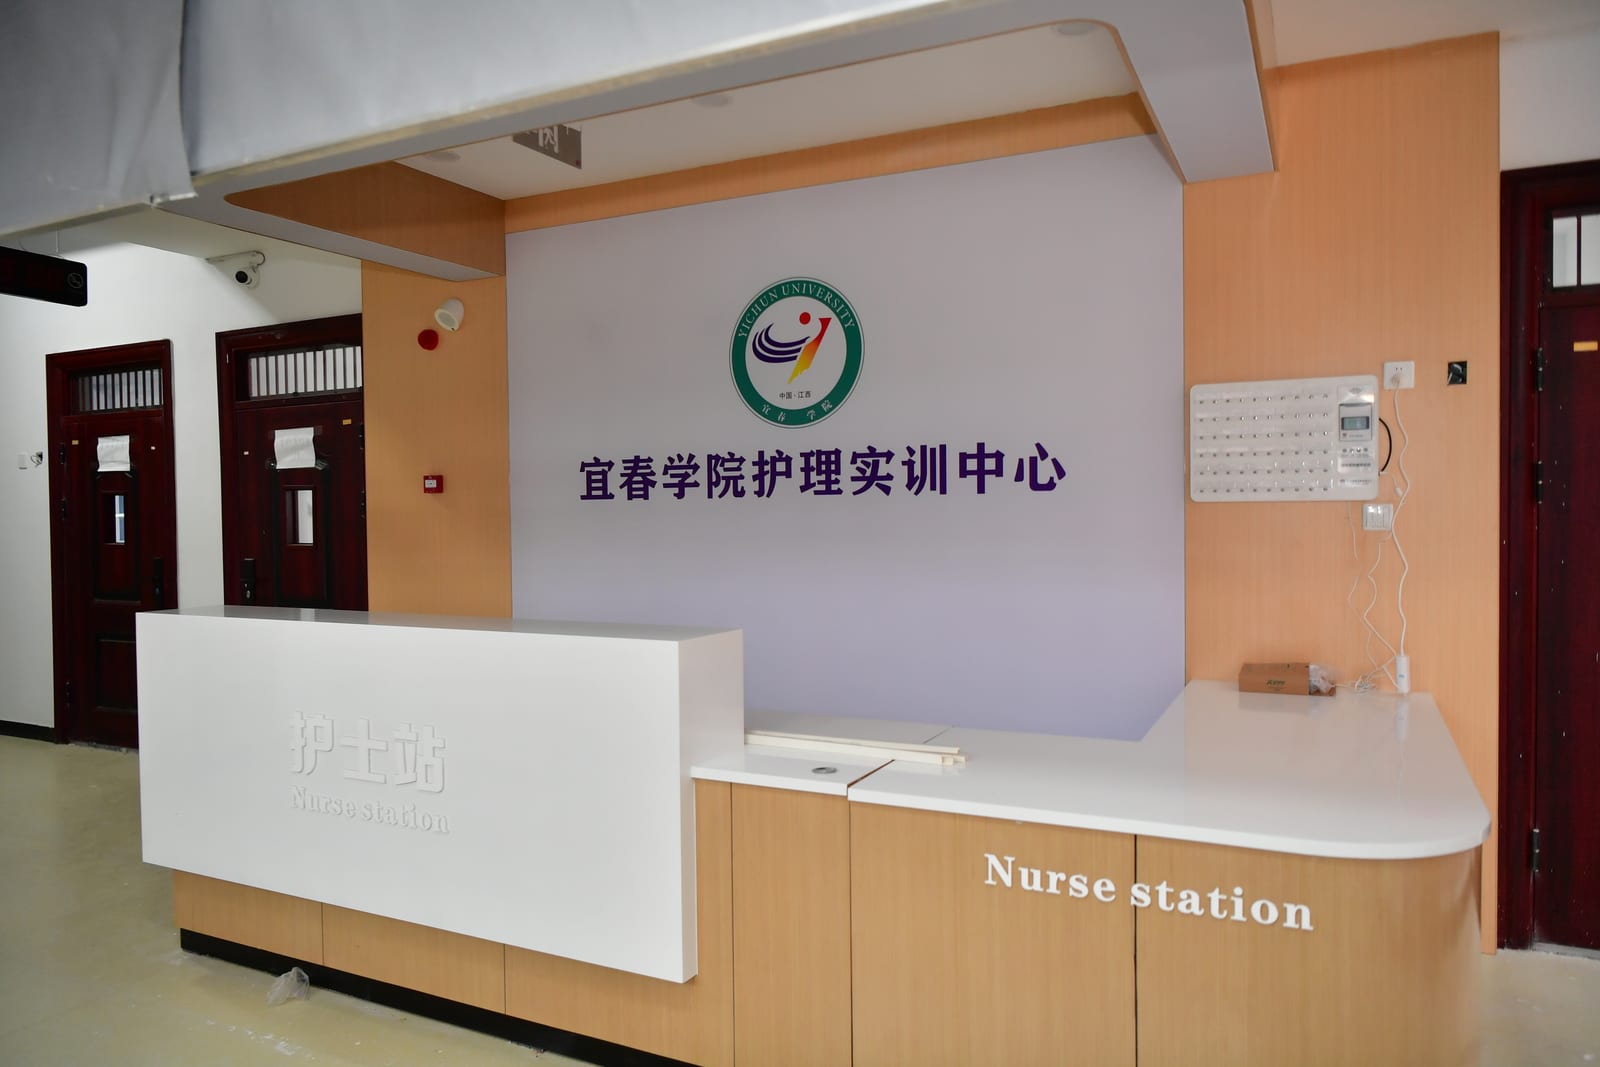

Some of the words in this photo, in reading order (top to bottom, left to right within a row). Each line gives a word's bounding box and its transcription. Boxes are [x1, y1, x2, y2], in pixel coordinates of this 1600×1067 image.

[737, 289, 778, 338] YICHUN
[781, 283, 855, 330] UNIVERSITY
[580, 442, 1066, 500] 宜春学院护理实训中心
[289, 711, 447, 794] 护士站
[290, 785, 356, 818] Nurse
[361, 801, 450, 835] station
[984, 853, 1116, 902] Nurse
[1130, 880, 1314, 931] station
